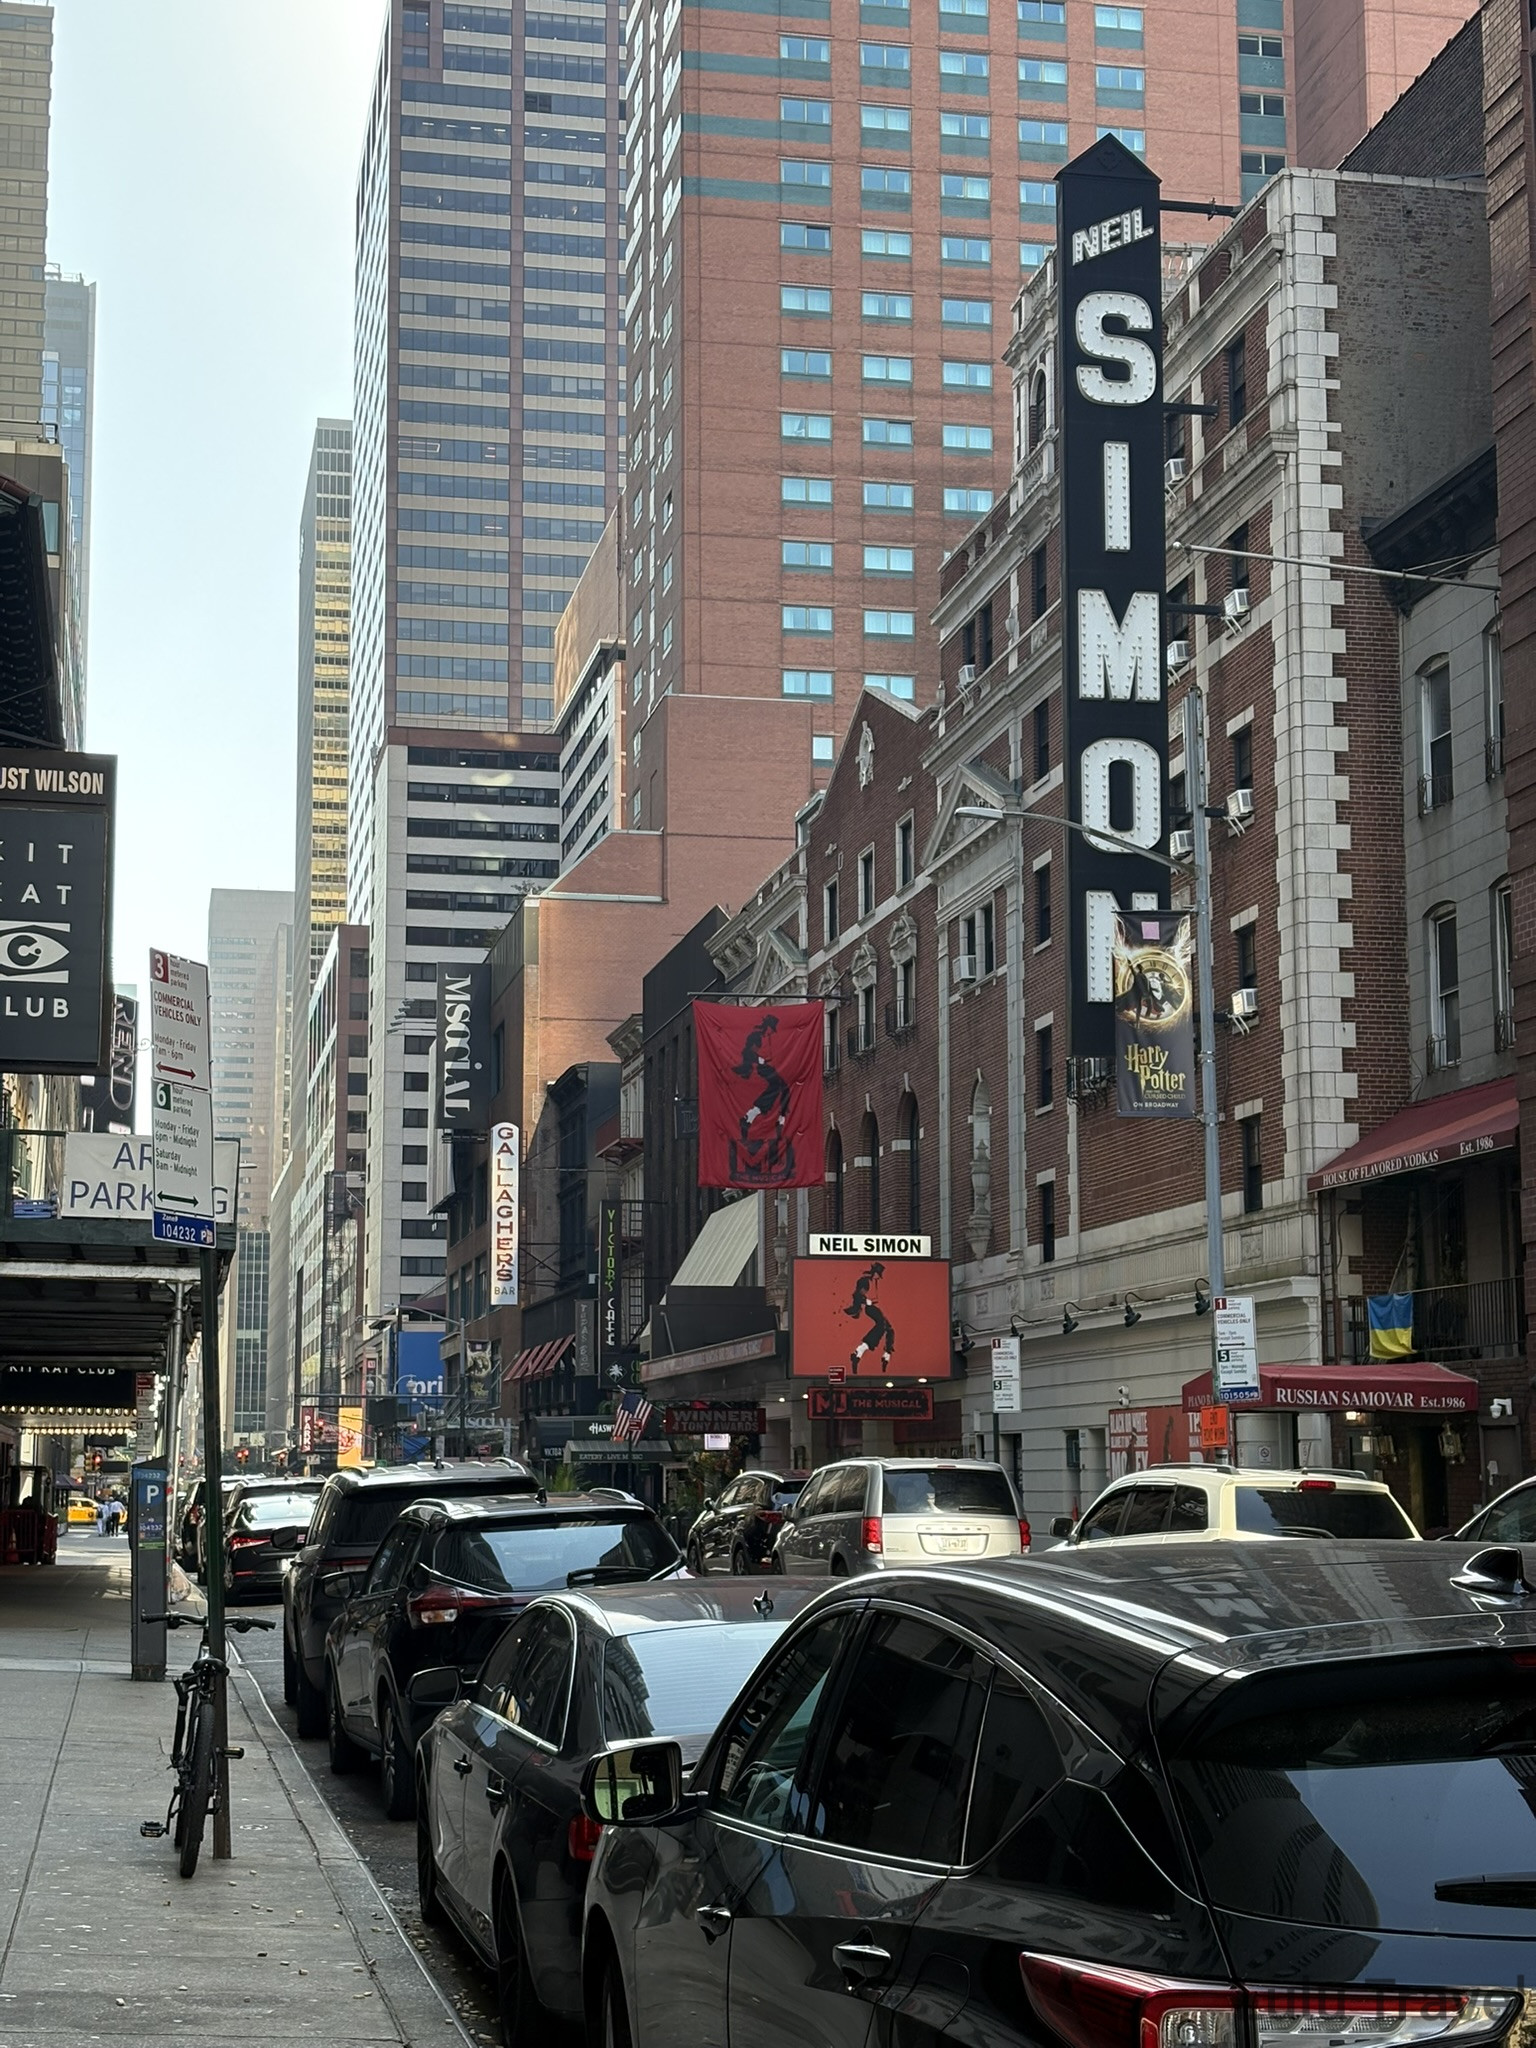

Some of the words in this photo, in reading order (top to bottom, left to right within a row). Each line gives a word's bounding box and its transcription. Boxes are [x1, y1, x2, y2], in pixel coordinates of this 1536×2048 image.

[1072, 206, 1155, 266] NEIL
[35, 770, 104, 795] WILSON
[0, 882, 72, 905] AT
[154, 954, 164, 979] 3
[170, 978, 188, 991] parking
[154, 990, 195, 1012] COMMERCIAL
[155, 1004, 185, 1023] VEHICLES
[185, 1013, 202, 1027] ONLY
[155, 1032, 176, 1048] Monday
[180, 1039, 197, 1054] Friday
[1124, 1043, 1169, 1073] Harry
[1139, 1065, 1186, 1097] Potter
[156, 1083, 167, 1106] 6
[172, 1095, 193, 1107] metered
[172, 1104, 191, 1118] parking
[155, 1118, 176, 1133] Monday
[182, 1123, 199, 1138] Friday
[155, 1131, 168, 1143] 6pm
[173, 1133, 197, 1148] Midnight
[1459, 1141, 1475, 1156] Est.
[1475, 1135, 1494, 1152] 1986
[155, 1148, 181, 1162] Saturday
[155, 1160, 168, 1171] 8am
[173, 1162, 198, 1177] Midnight
[1322, 1170, 1348, 1187] HOUSE
[1348, 1167, 1360, 1181] OF
[1360, 1158, 1402, 1179] FLAVORED
[1403, 1149, 1439, 1169] VODKAS
[69, 1181, 229, 1215] PARKG
[496, 1127, 514, 1281] GALLAGHER'S
[161, 1222, 197, 1242] 104232
[819, 1237, 859, 1252] NEIL
[863, 1238, 922, 1254] SIMON
[494, 1286, 515, 1295] BAR
[1220, 1351, 1227, 1361] 5
[852, 1399, 872, 1408] THE
[875, 1399, 921, 1408] MUSICAL
[1220, 1391, 1250, 1400] 101505
[1276, 1387, 1339, 1405] RUSSIAN
[1342, 1391, 1413, 1407] SAMOVAR
[673, 1410, 758, 1422] WINNER!
[673, 1423, 678, 1431] 4
[683, 1422, 709, 1431] TONY
[713, 1422, 759, 1432] AWARDS
[147, 1485, 160, 1504] P
